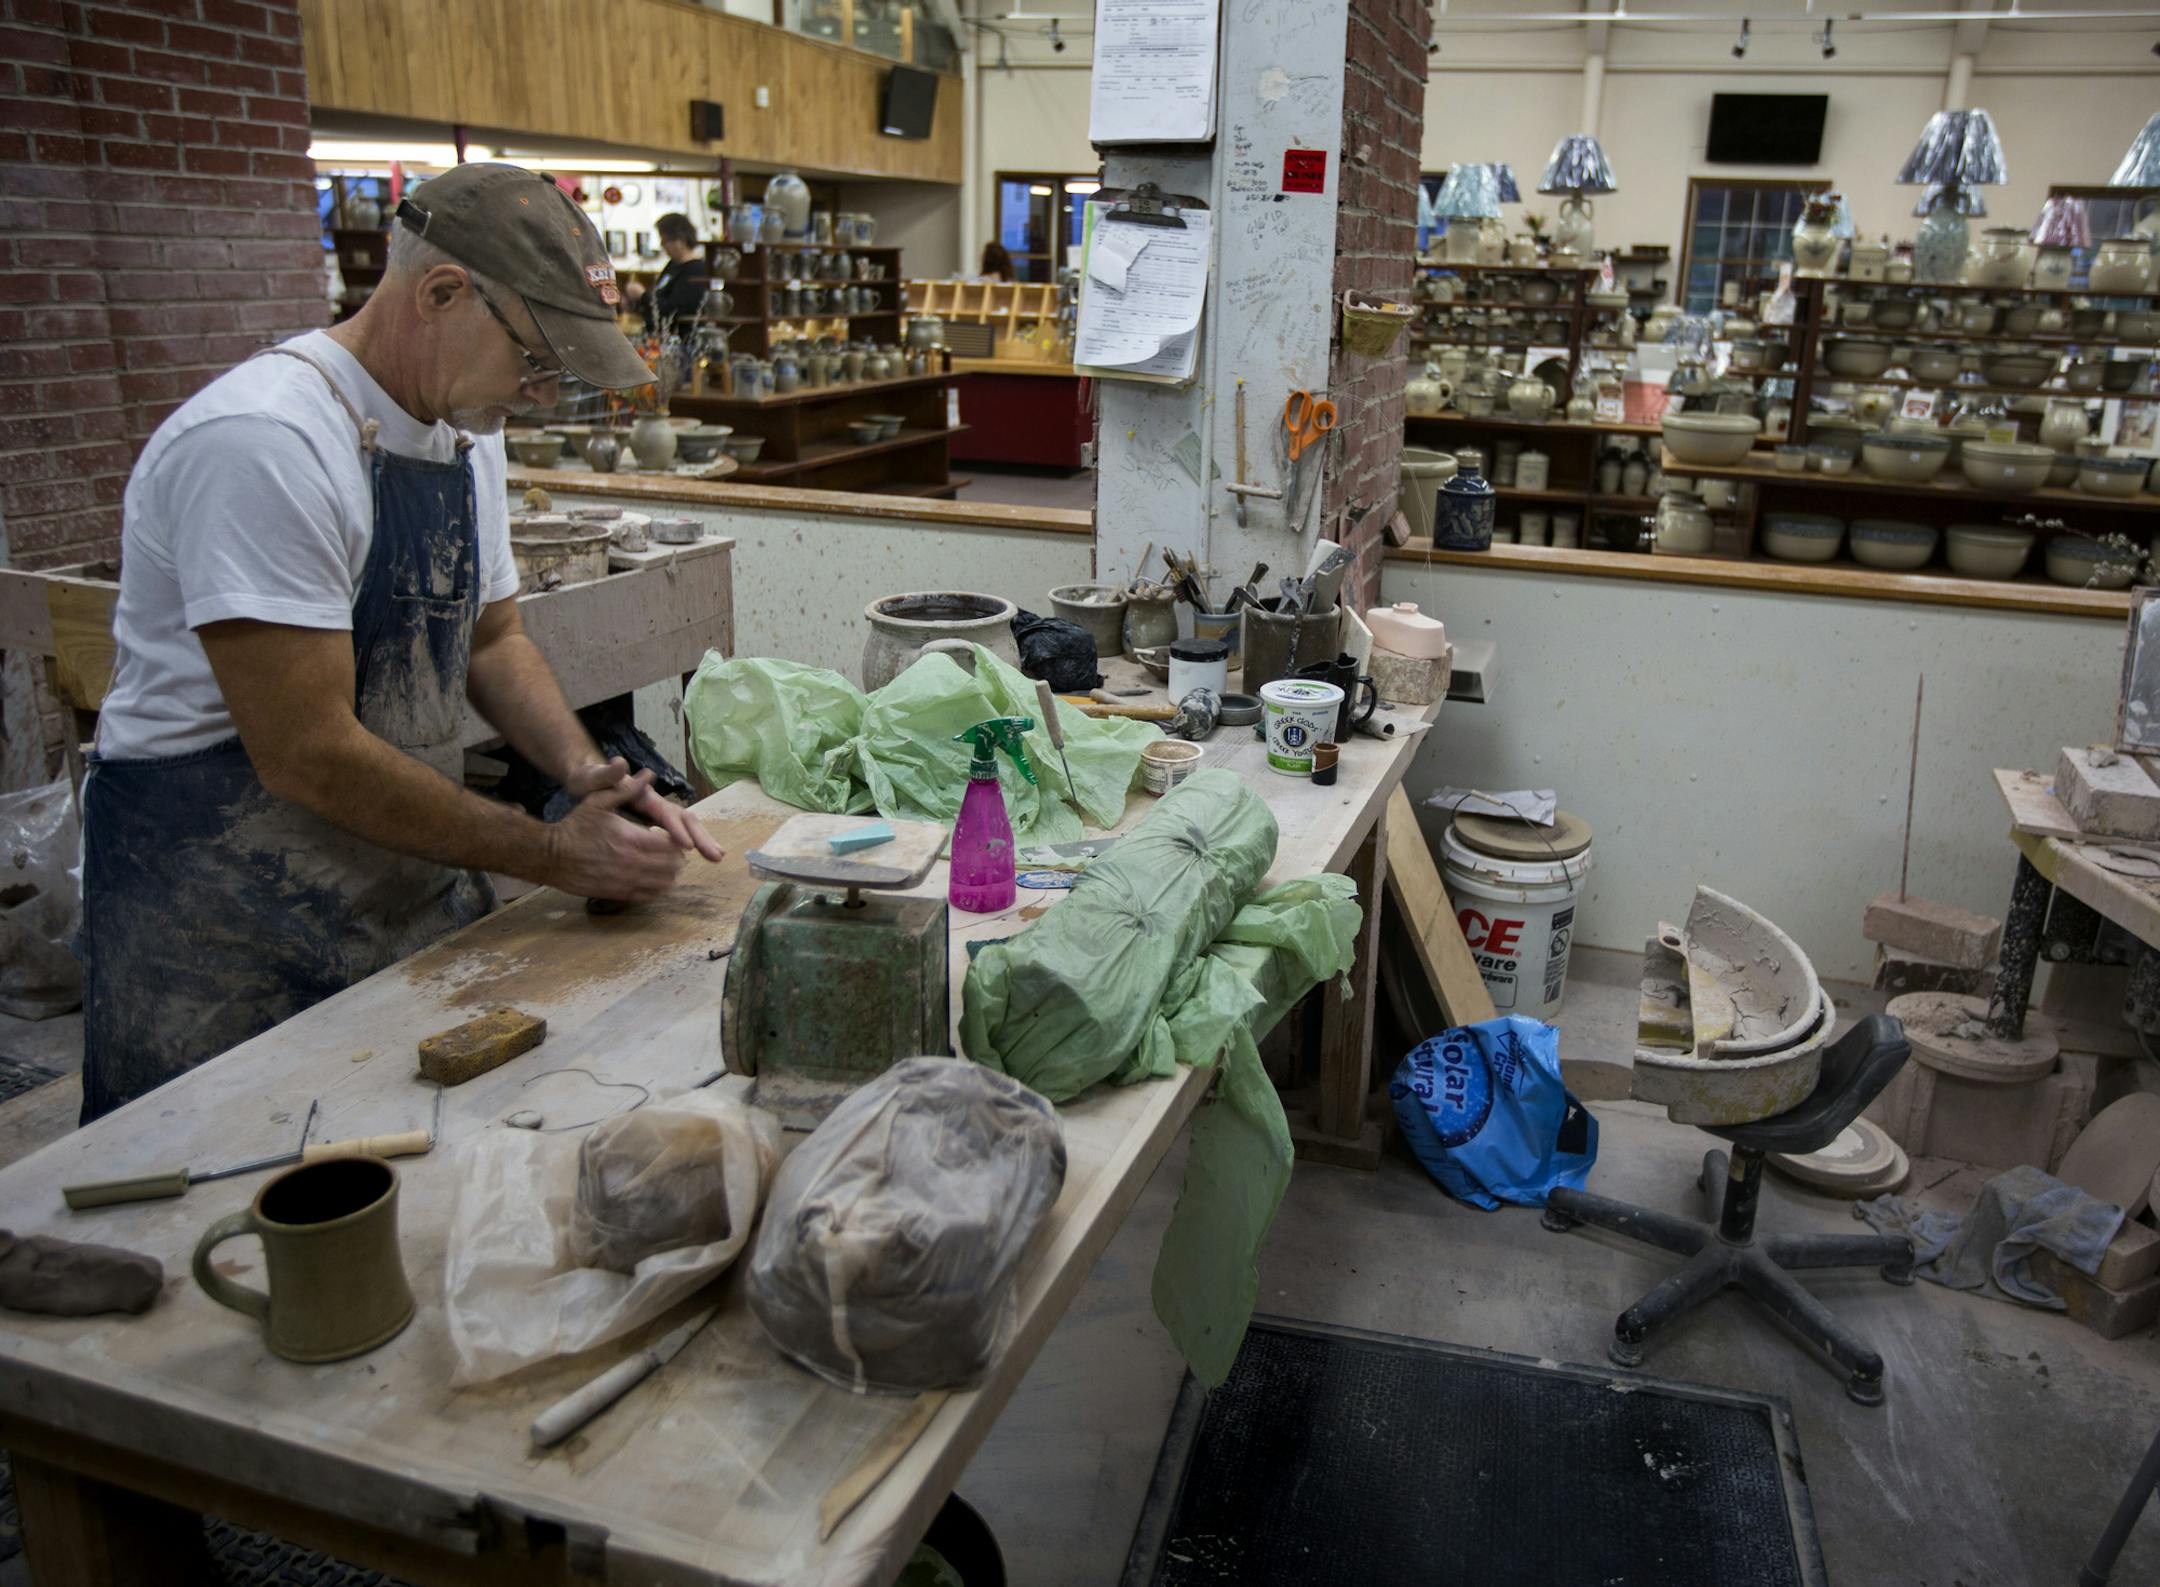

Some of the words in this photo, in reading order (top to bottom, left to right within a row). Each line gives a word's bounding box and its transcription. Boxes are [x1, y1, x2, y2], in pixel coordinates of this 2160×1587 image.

[1273, 715, 1295, 730] GREEK
[1296, 717, 1320, 732] GODS
[1292, 743, 1315, 757] YOGU
[1455, 906, 1525, 956] CE
[1442, 1032, 1470, 1110] Solar
